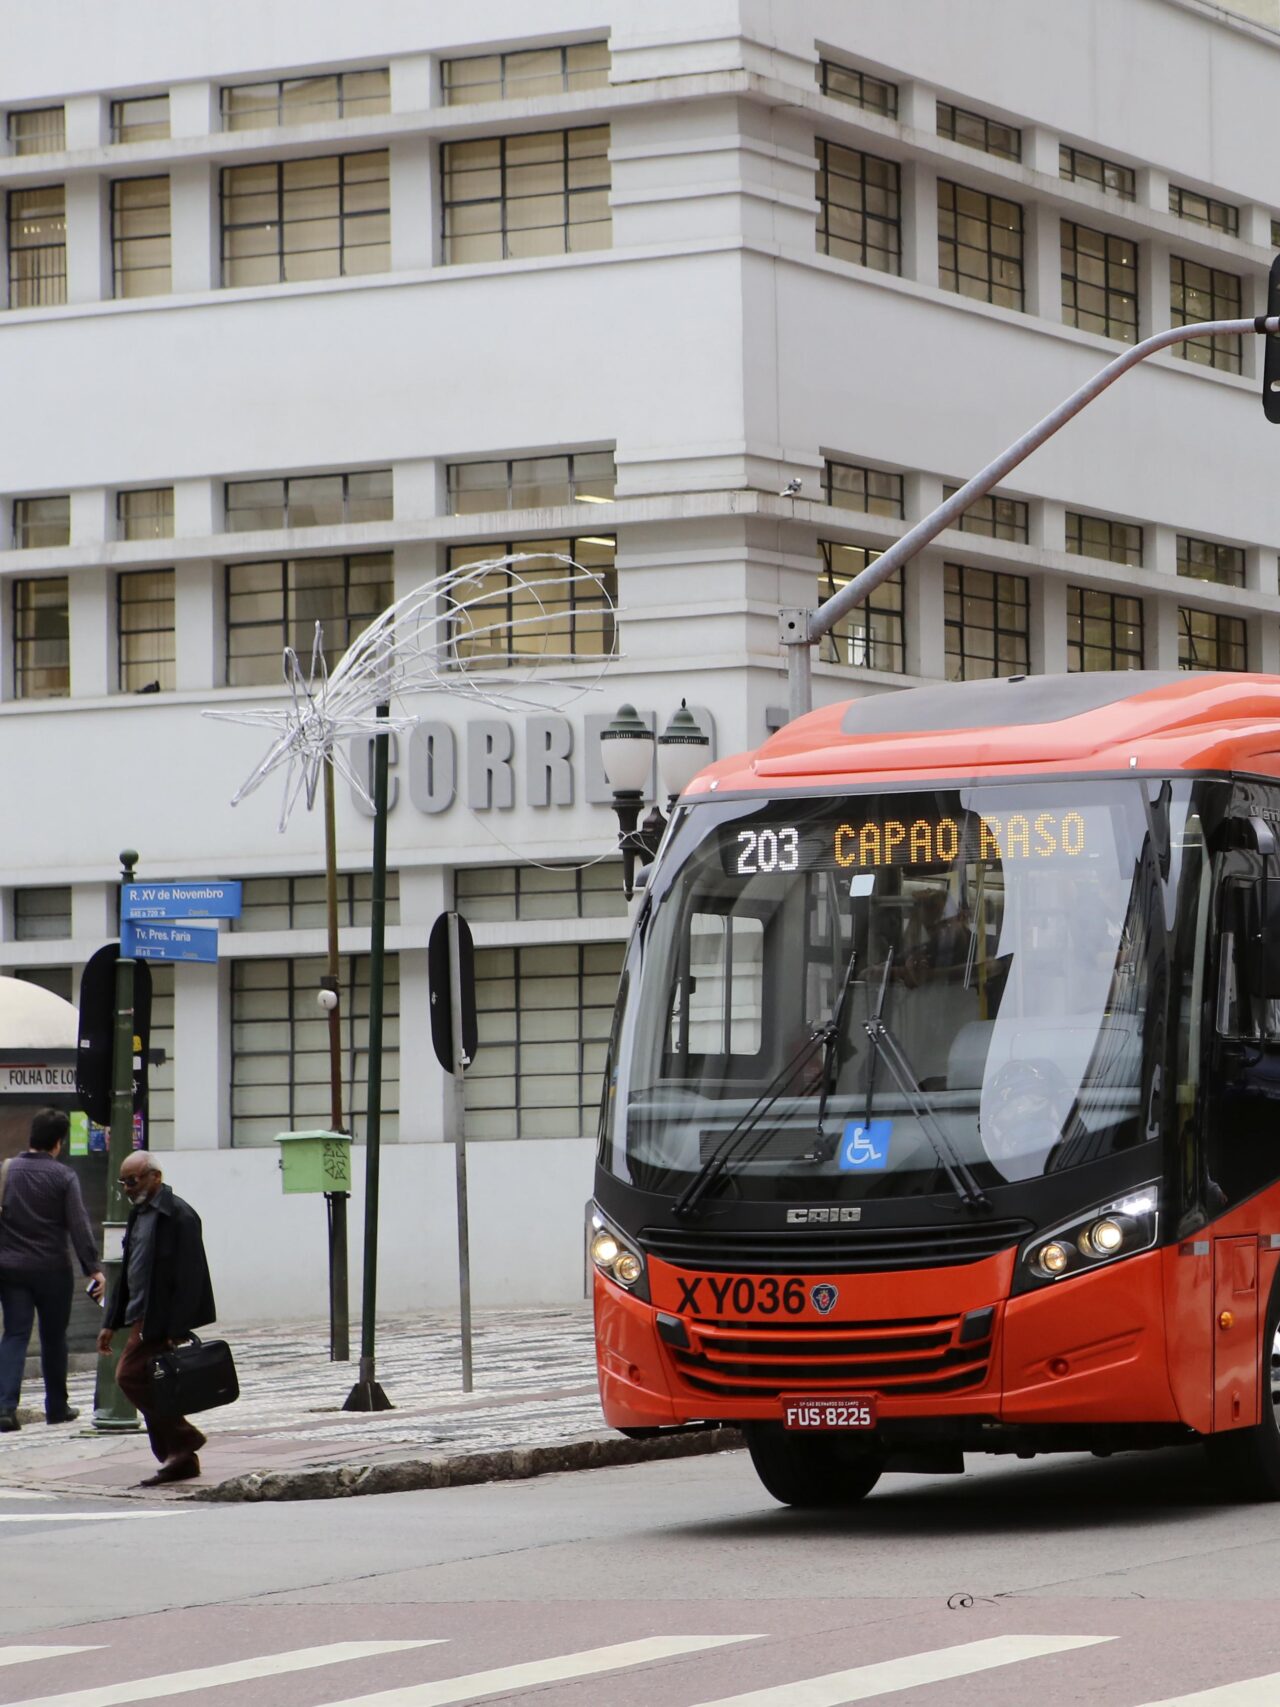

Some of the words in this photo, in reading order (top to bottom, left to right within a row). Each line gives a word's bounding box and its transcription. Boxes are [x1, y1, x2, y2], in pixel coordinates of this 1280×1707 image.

[738, 828, 799, 875] 203
[834, 819, 959, 867] CAPAO
[979, 812, 1086, 860] RASO
[130, 890, 140, 900] R.
[142, 889, 156, 900] XV
[158, 889, 170, 899] de
[172, 888, 224, 899] Novembro
[135, 928, 148, 939] Tv.
[149, 929, 169, 941] Pres.
[171, 930, 191, 942] Faria
[9, 1069, 43, 1086] FOLHA
[45, 1069, 59, 1085] DE
[61, 1069, 77, 1085] LO
[786, 1207, 861, 1223] CAIO
[676, 1277, 806, 1314] XY036
